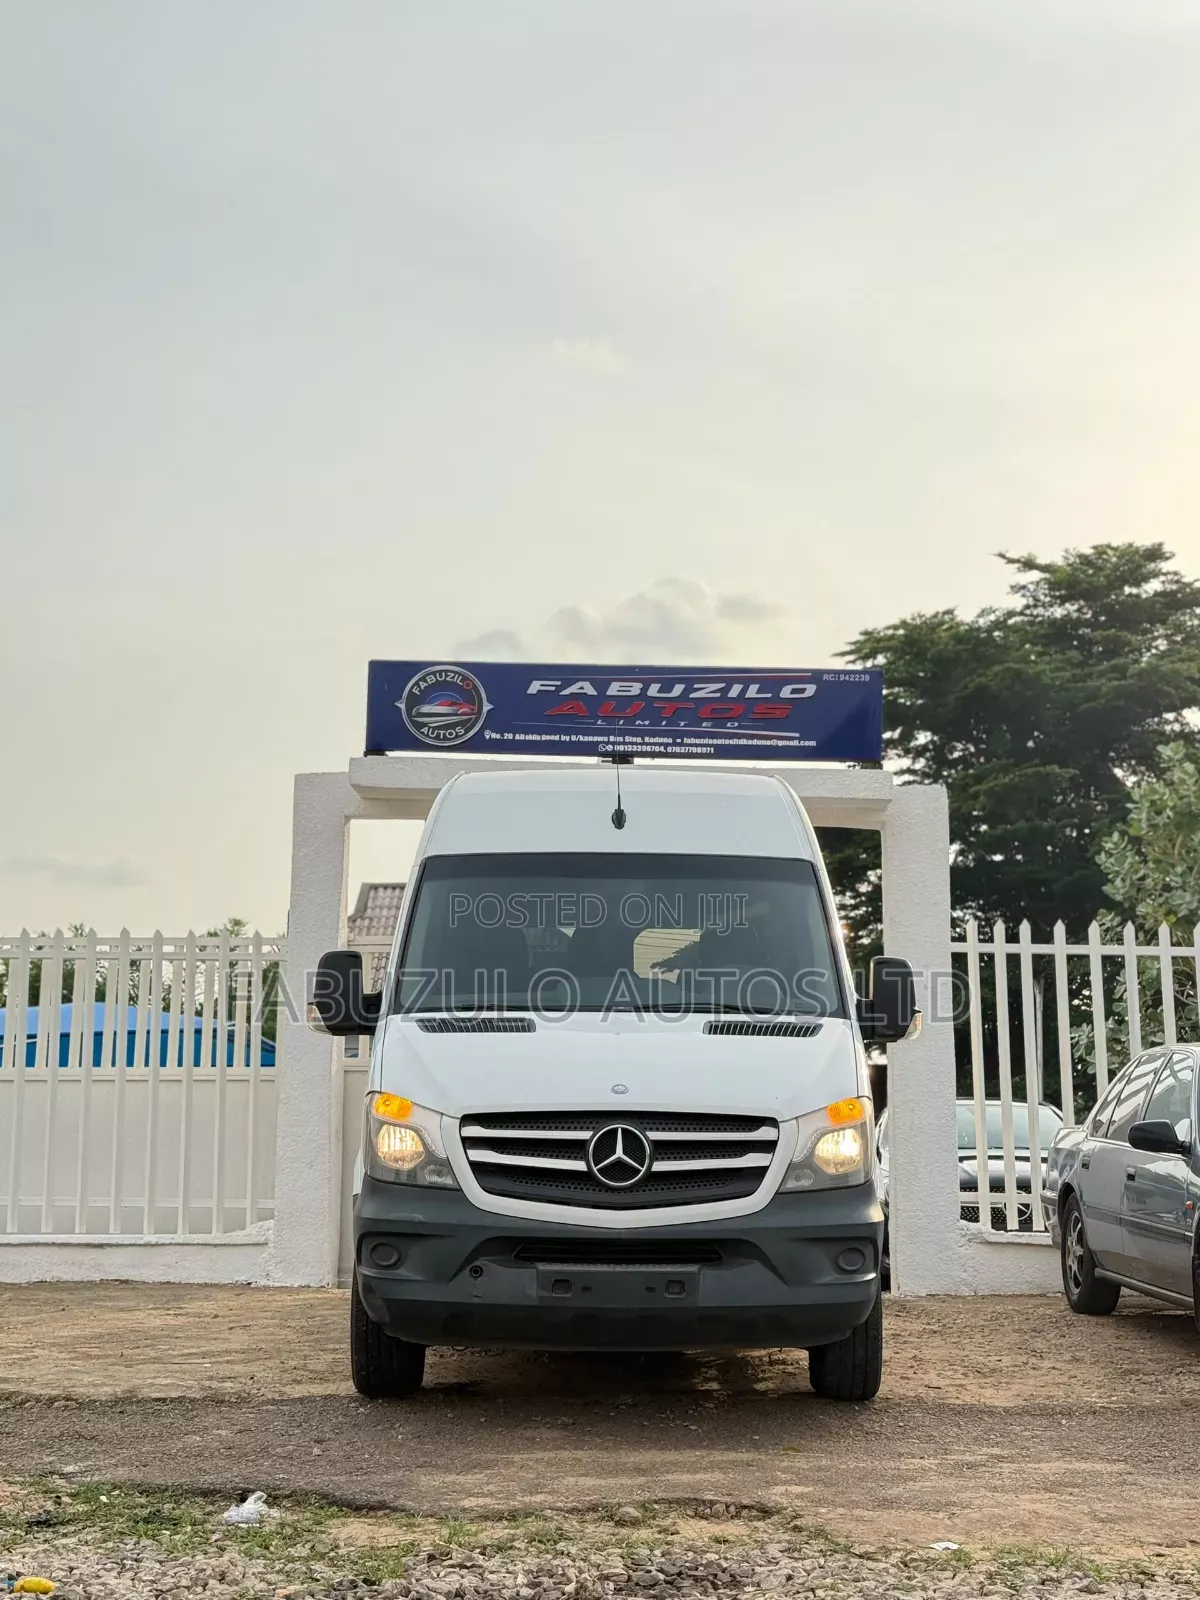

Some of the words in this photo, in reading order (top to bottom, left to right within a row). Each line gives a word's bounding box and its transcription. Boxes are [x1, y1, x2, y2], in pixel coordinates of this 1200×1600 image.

[412, 672, 472, 695] FABUZILO
[526, 680, 817, 699] FABUZILO
[544, 701, 793, 719] AUTOS
[597, 719, 739, 727] LIMITED
[421, 726, 465, 739] AUTOS
[560, 734, 570, 742] by
[609, 735, 624, 743] Bus
[624, 736, 644, 744] Stop,
[644, 736, 673, 744] Kaduna
